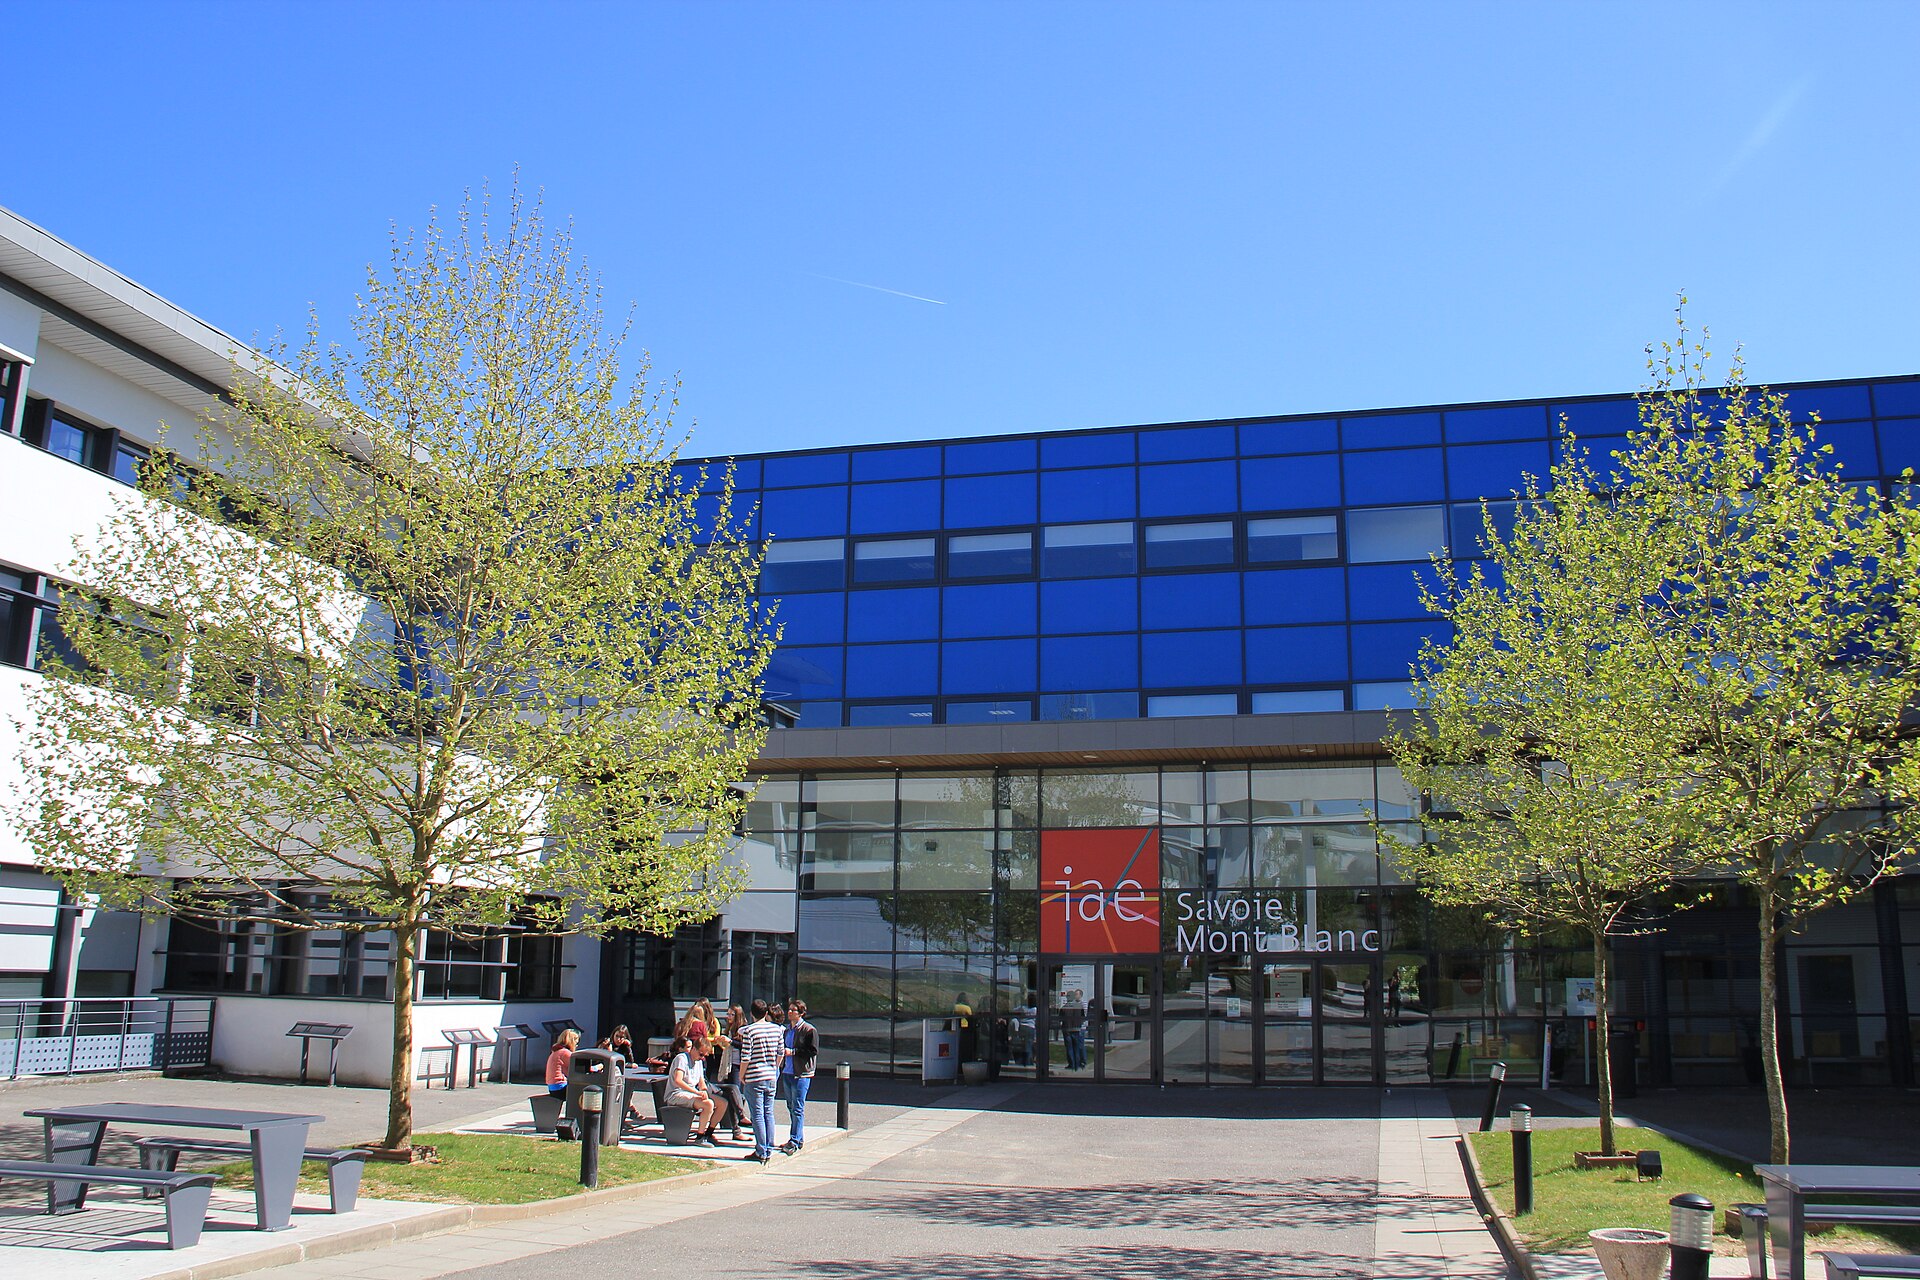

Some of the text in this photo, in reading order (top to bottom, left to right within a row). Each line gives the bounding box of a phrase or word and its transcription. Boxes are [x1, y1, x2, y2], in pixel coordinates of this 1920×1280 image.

[1055, 865, 1145, 922] iae
[1177, 892, 1283, 920] Savoie
[1177, 923, 1379, 953] Mont Blanc
